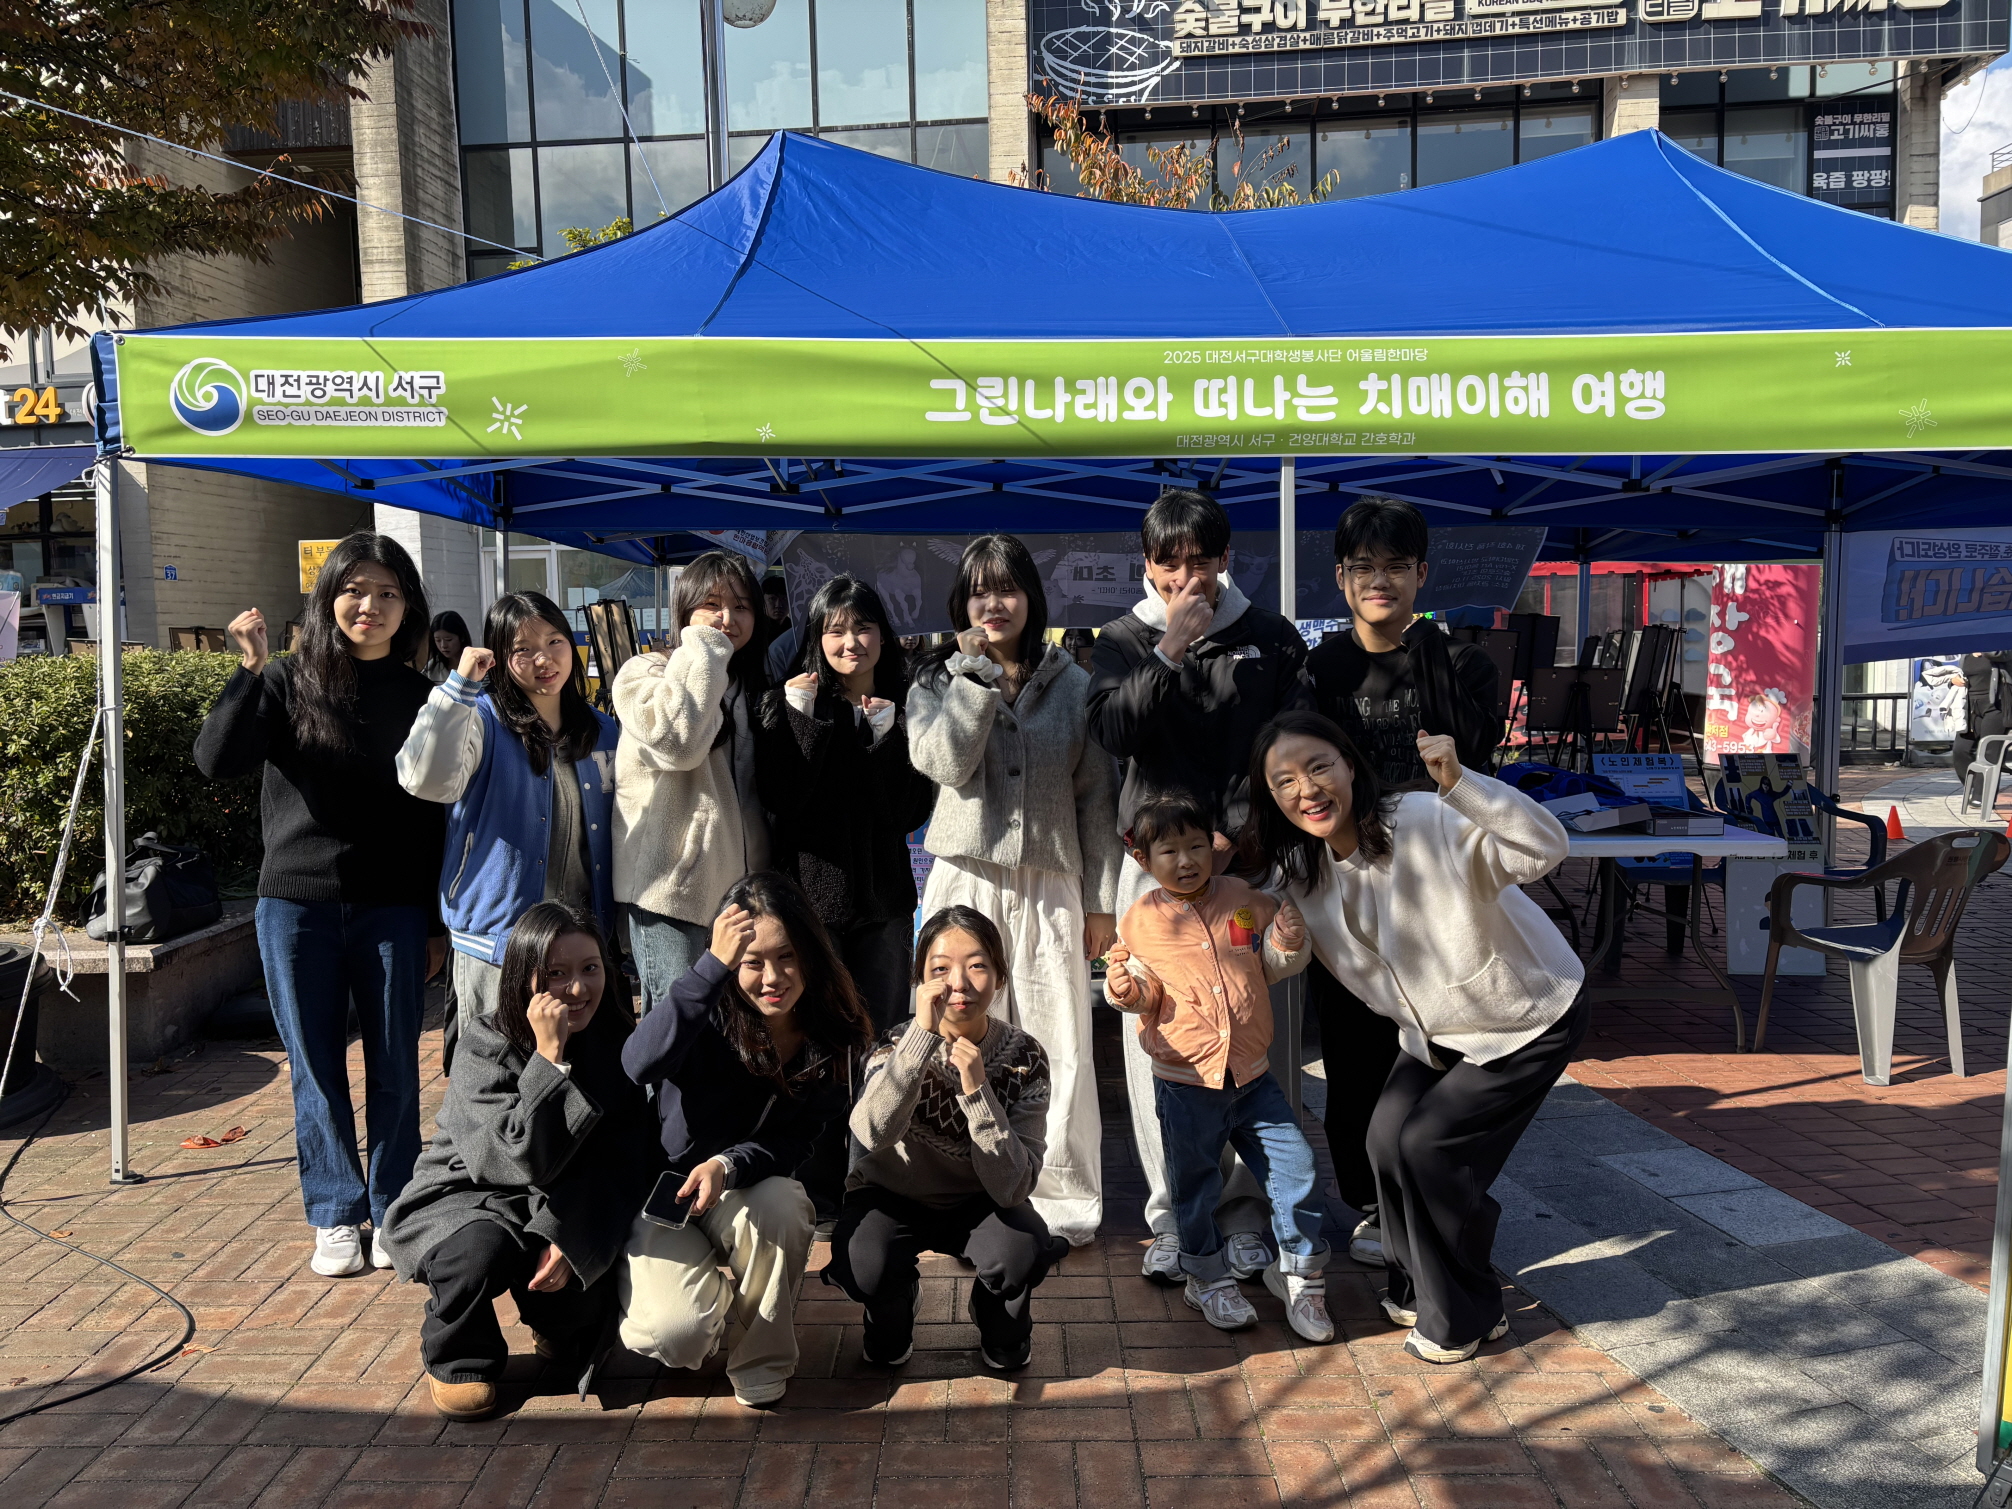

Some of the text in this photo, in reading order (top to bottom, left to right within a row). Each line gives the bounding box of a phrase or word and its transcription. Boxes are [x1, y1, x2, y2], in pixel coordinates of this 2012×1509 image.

[1814, 112, 1890, 126] 숯불구이 무한리필
[1830, 124, 1889, 139] 고기싸롱
[1813, 171, 1846, 190] 육즙
[1163, 347, 1429, 364] 2025 대전서구대학생봉사단 어울림한마당
[253, 373, 443, 400] 대전광역시 서구
[925, 369, 1667, 425] 그린나래와 떠나는 치매이해 여행
[257, 409, 445, 423] SEO-GU DAEJEON DISTRICT
[1176, 432, 1416, 448] 대전광역시 서구 건양대학교 간호학과
[1787, 850, 1806, 861] 체험
[1808, 849, 1820, 861] 후
